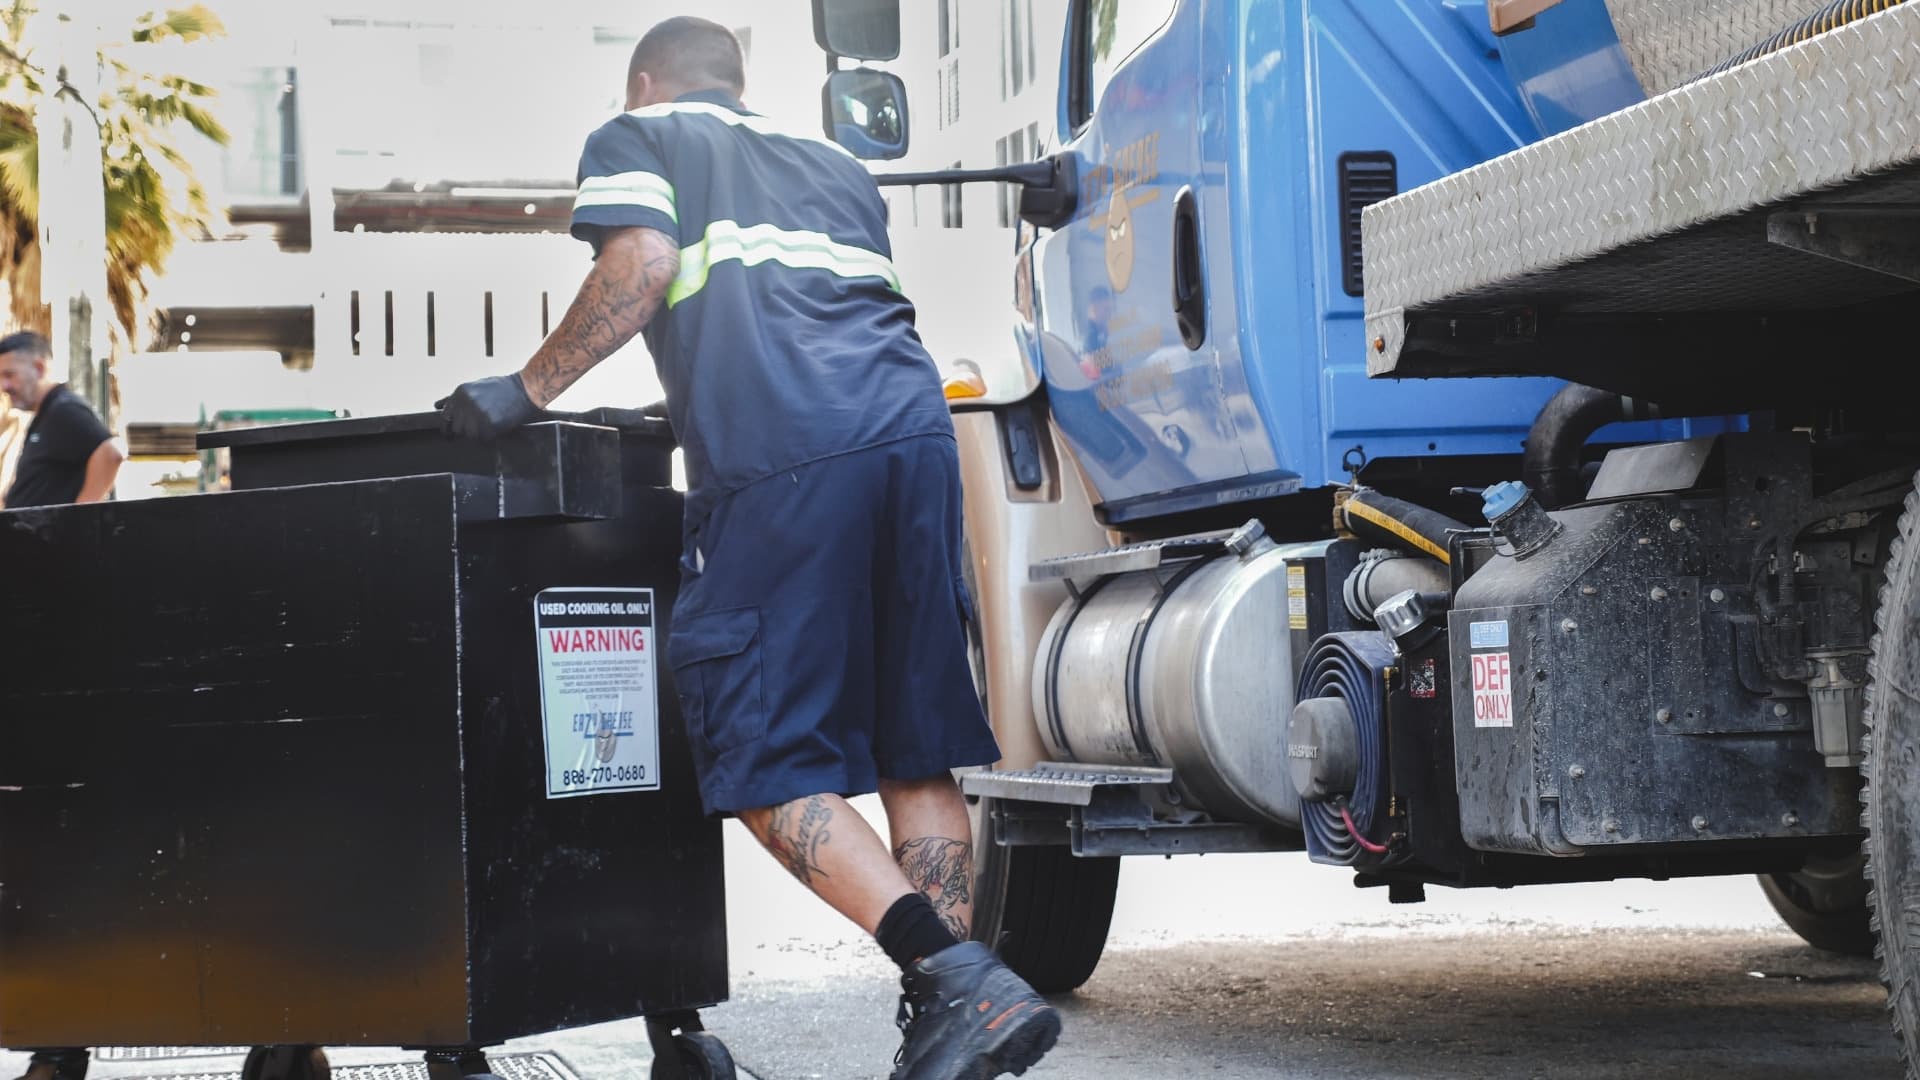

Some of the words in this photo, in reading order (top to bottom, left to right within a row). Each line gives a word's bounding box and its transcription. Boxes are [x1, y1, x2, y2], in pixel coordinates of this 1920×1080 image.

[540, 603, 566, 615] USED
[568, 603, 610, 615] COOKING
[611, 603, 626, 614] OIL
[627, 603, 650, 614] ONLY
[549, 629, 645, 653] WARNING
[1473, 655, 1508, 691] DEF
[1475, 694, 1510, 720] ONLY
[563, 765, 645, 786] 888-270-0680
